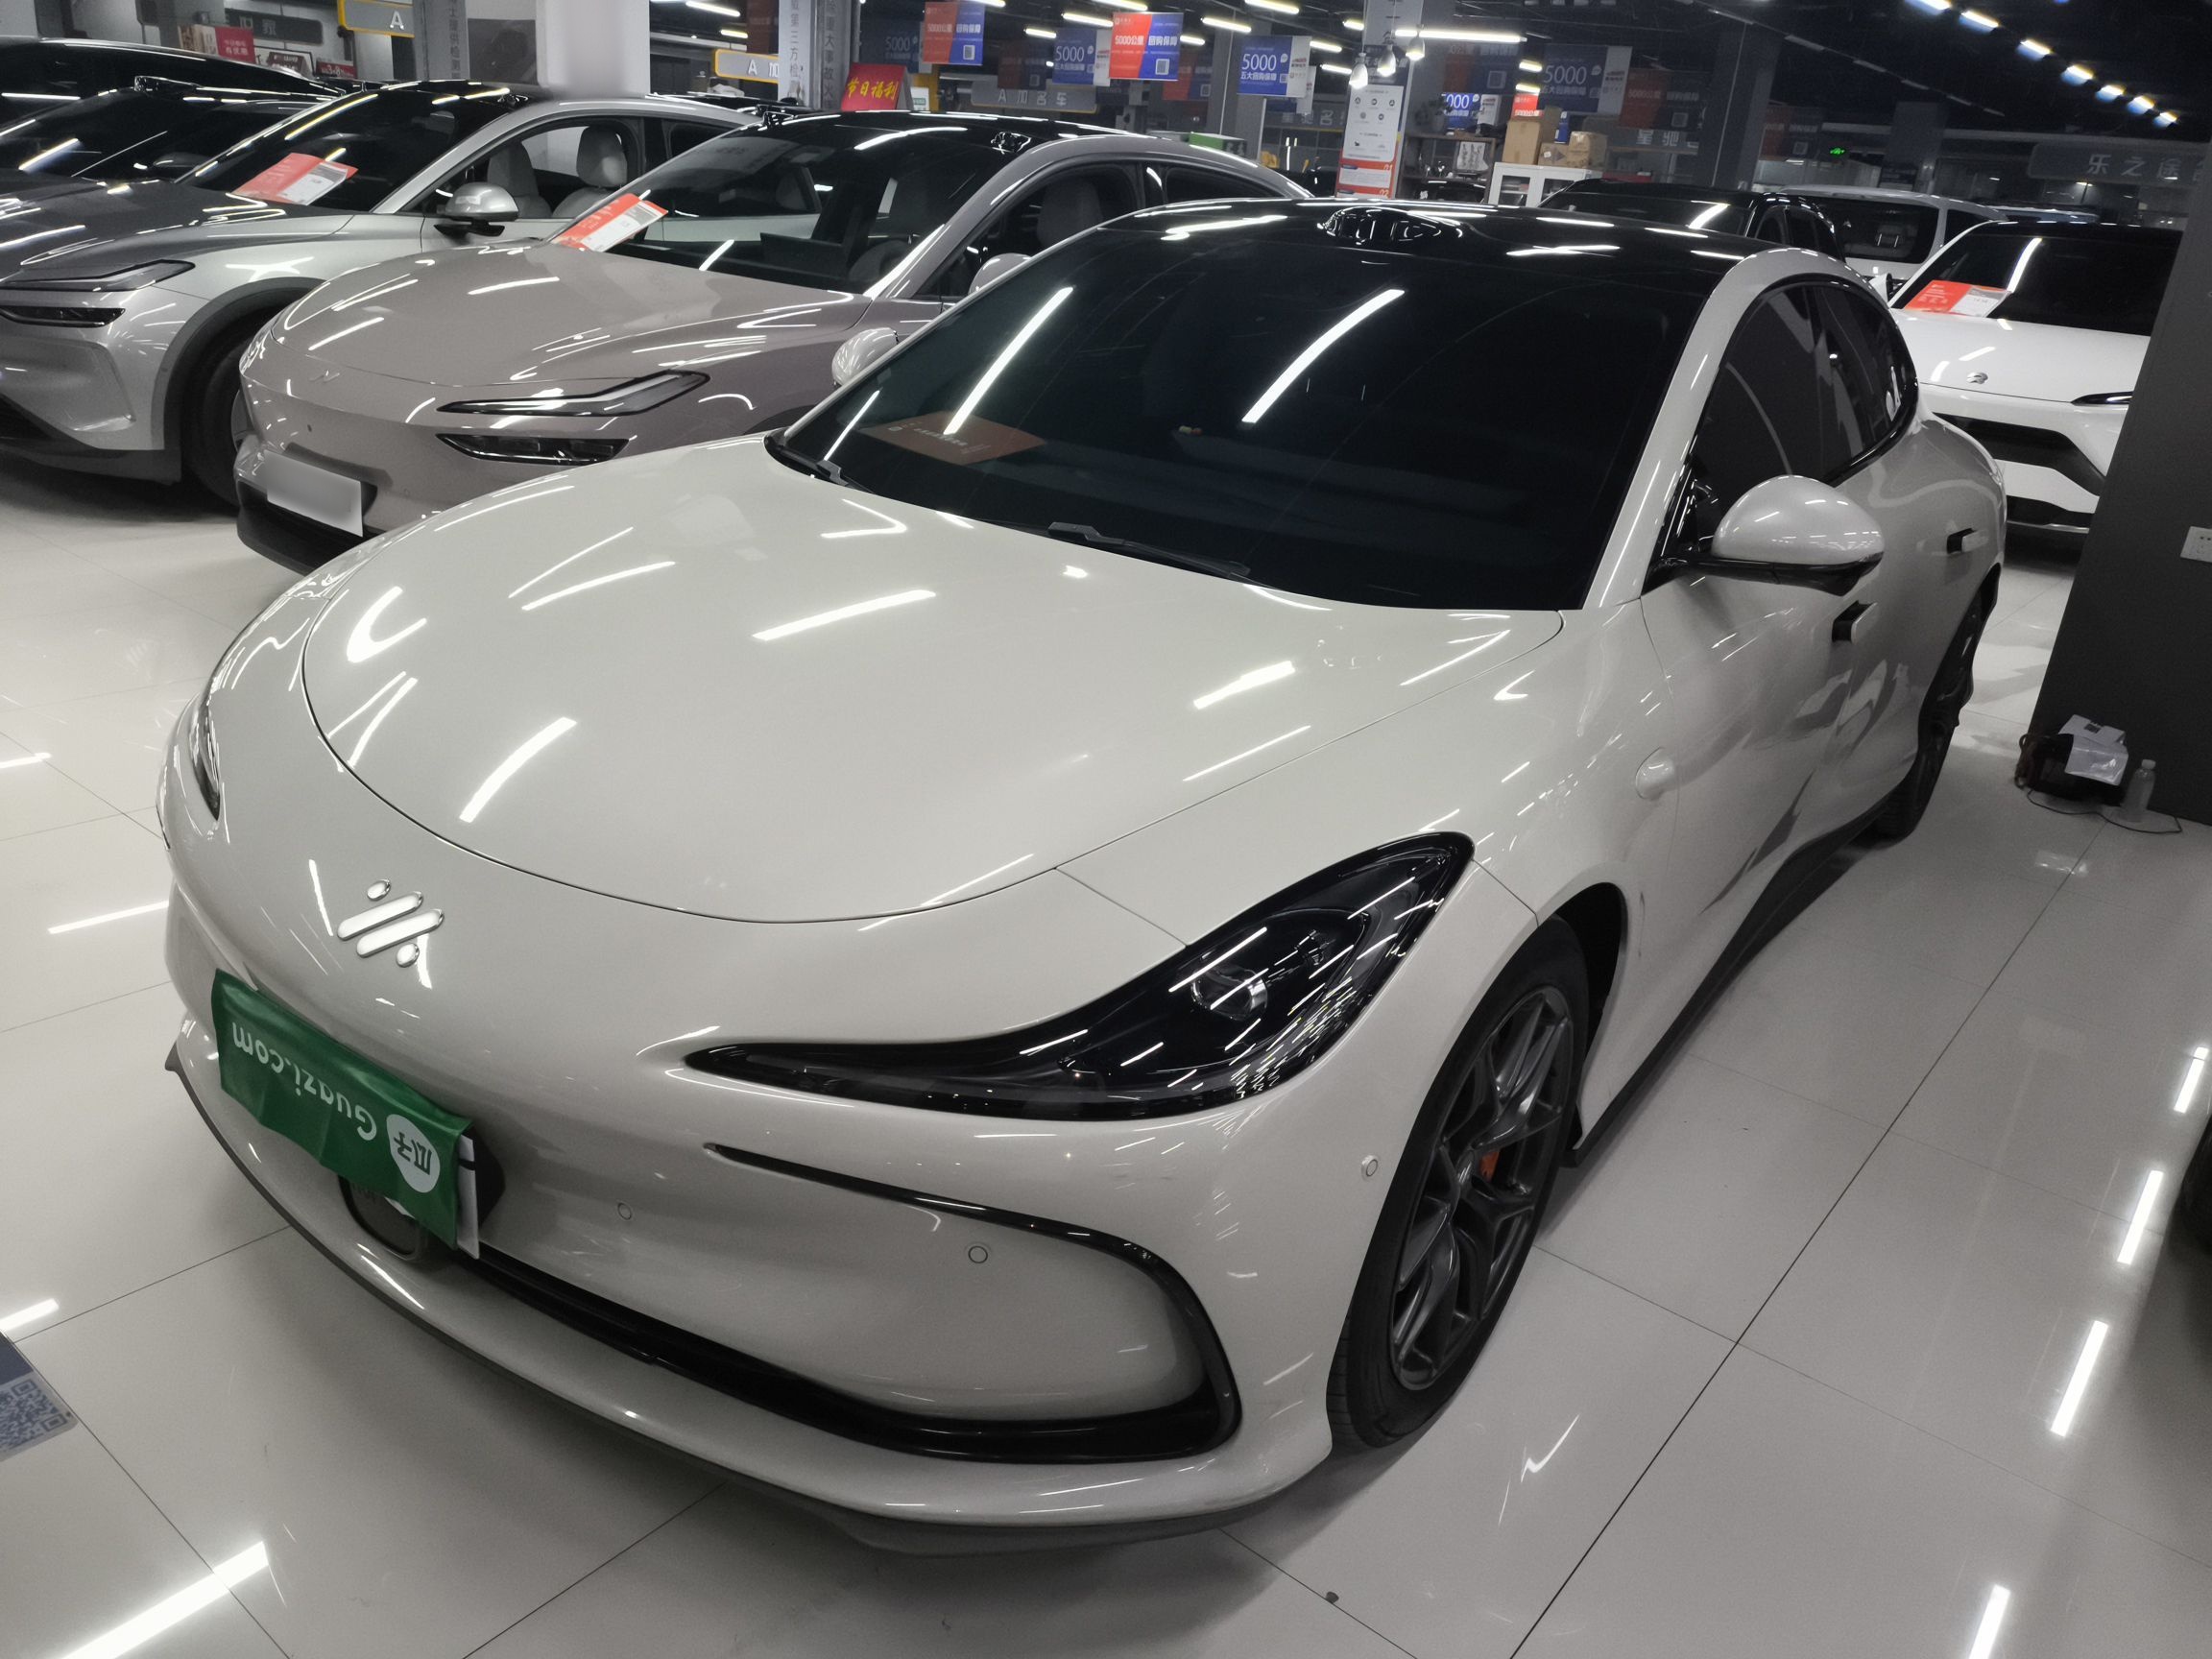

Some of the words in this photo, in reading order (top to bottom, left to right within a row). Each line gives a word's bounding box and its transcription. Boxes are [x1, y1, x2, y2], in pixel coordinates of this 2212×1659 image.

[390, 12, 404, 30] A
[1055, 46, 1085, 62] 5000
[1241, 53, 1277, 71] 5000
[1544, 64, 1587, 84] 5000
[847, 76, 899, 100] 节日福利
[1441, 94, 1470, 108] 000
[231, 1022, 377, 1141] Guazi.com
